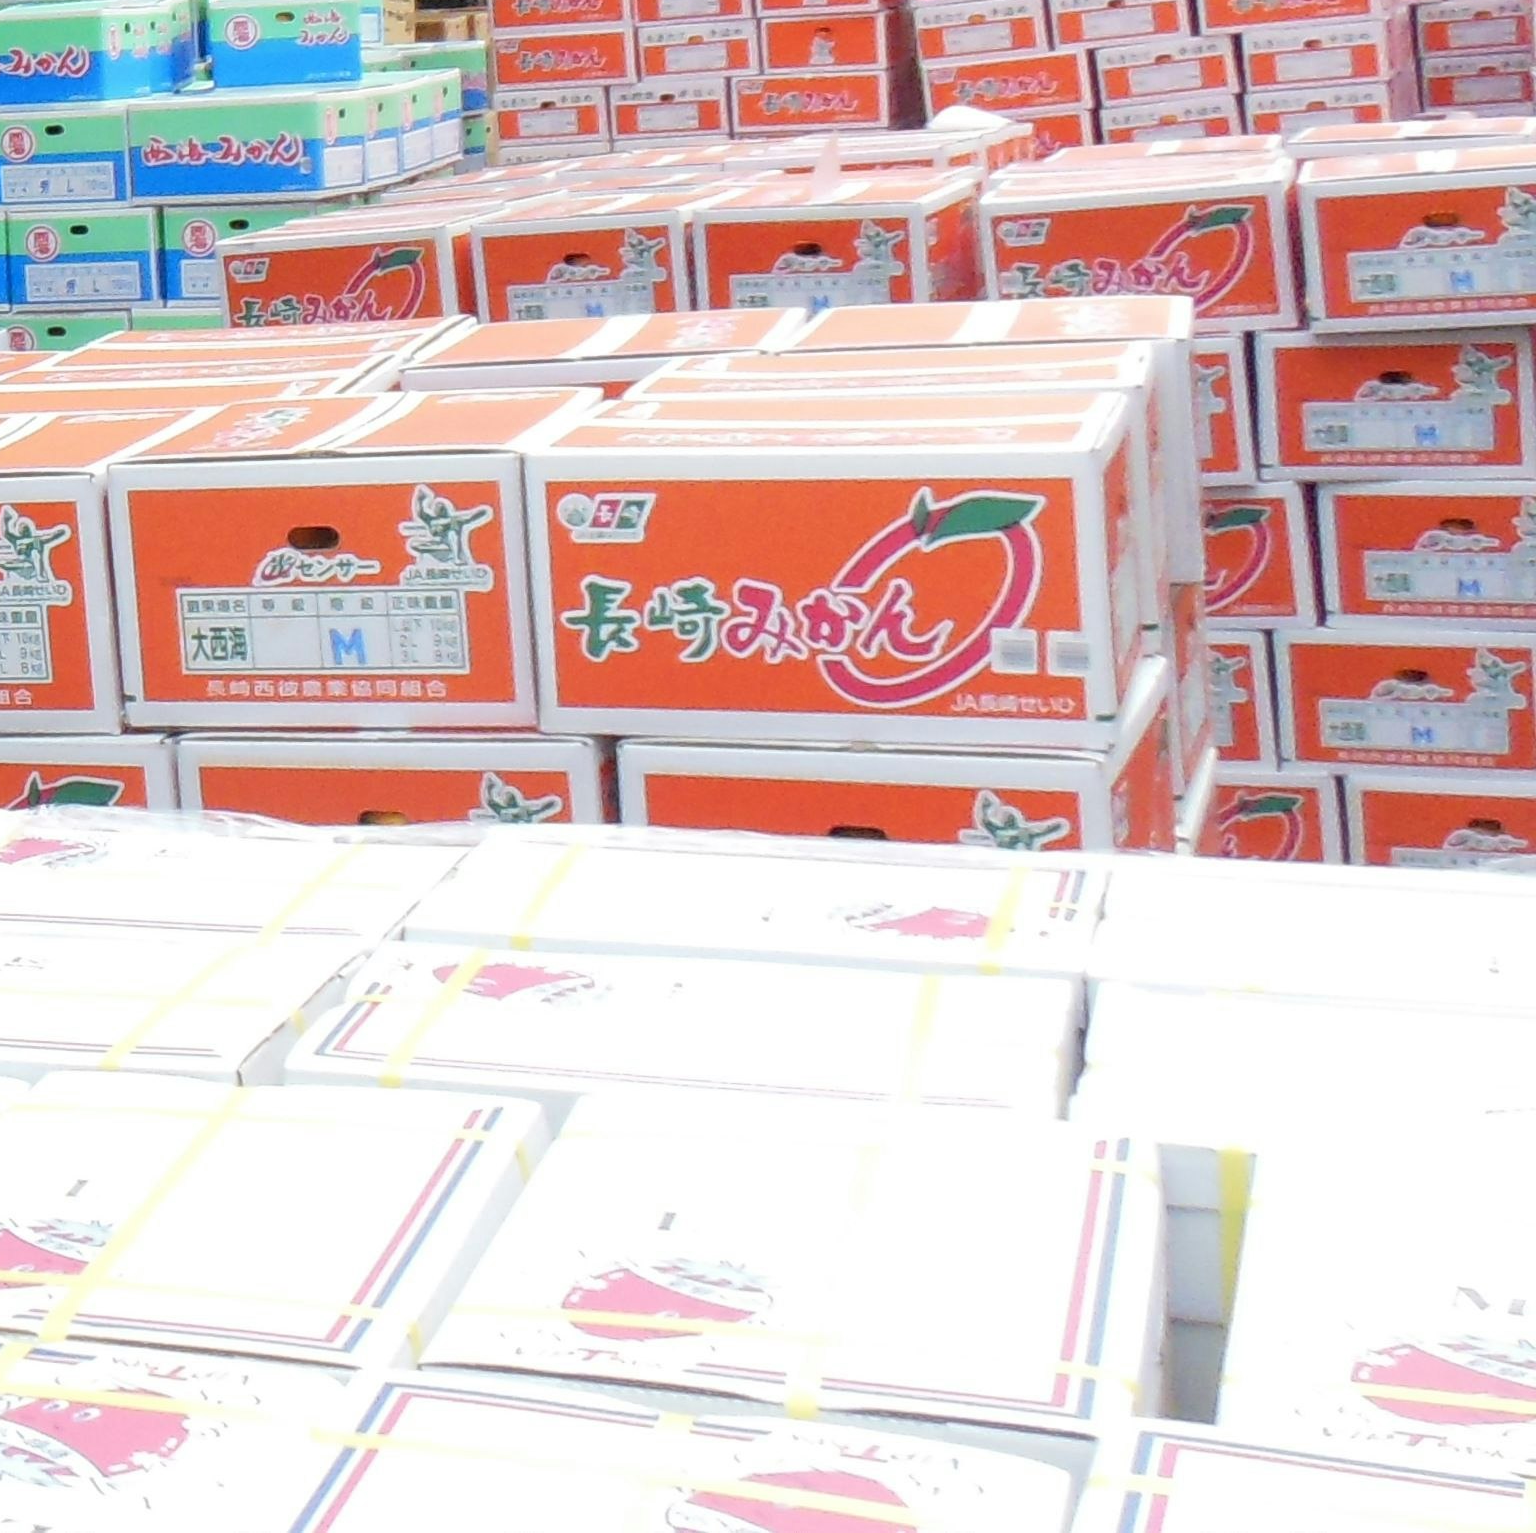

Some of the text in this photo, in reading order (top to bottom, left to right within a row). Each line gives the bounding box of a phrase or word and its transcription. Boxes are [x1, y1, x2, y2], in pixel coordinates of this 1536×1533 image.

[190, 626, 248, 662] 大西海
[329, 627, 368, 666] M
[565, 578, 952, 662] 長崎みかん
